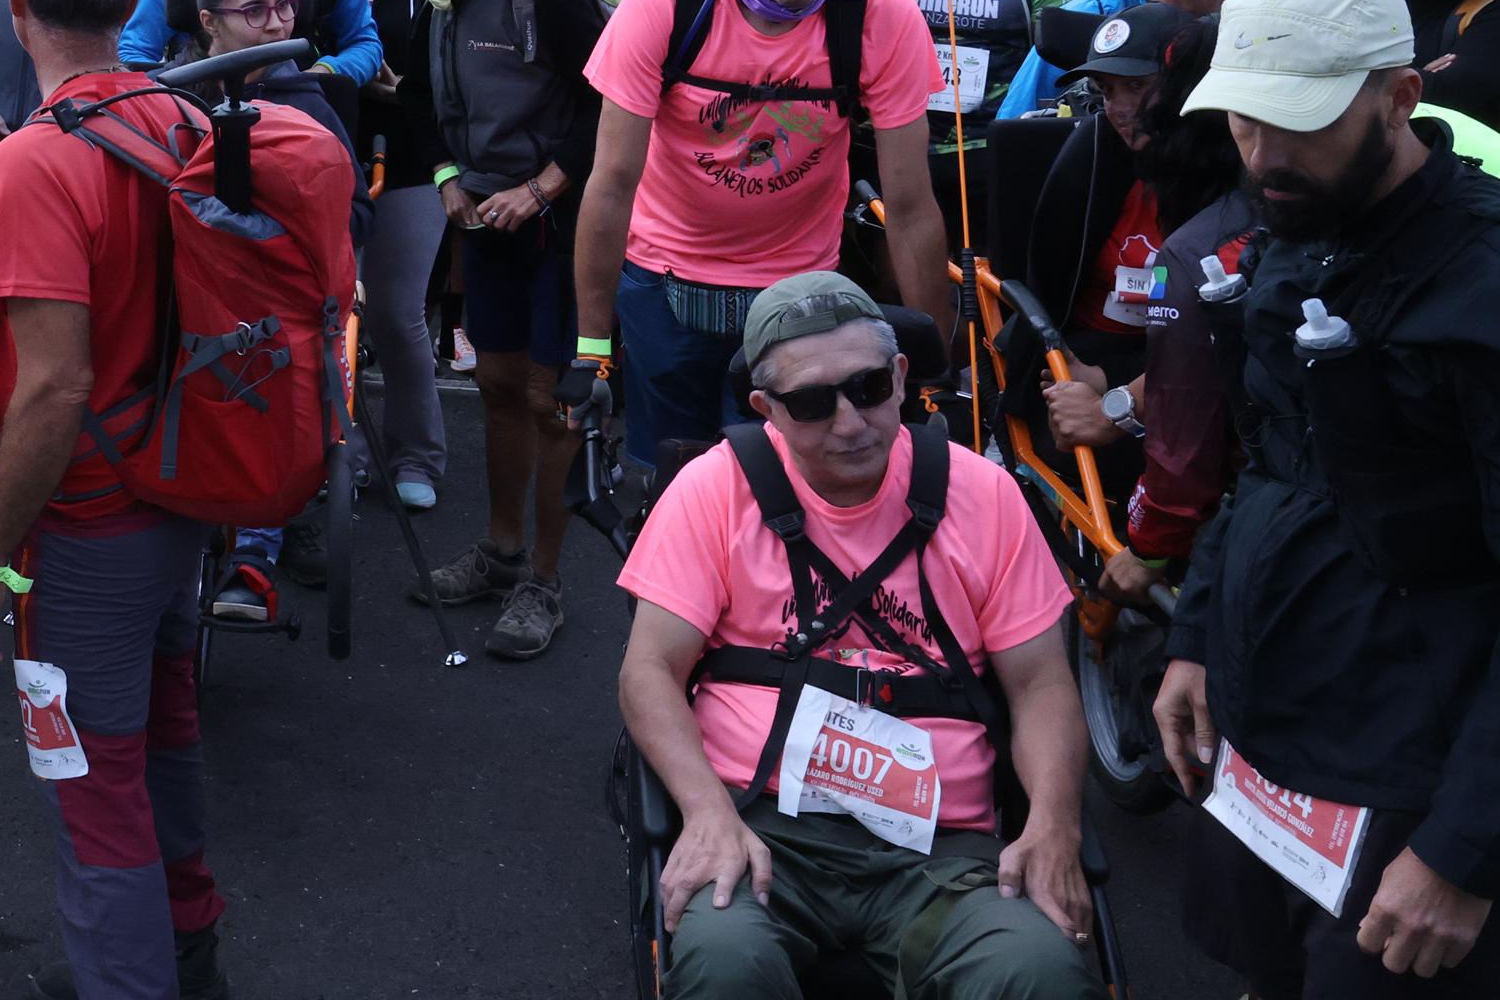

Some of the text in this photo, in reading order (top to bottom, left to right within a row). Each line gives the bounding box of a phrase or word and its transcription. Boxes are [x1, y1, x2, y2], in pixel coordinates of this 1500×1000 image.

[1127, 279, 1145, 291] SIN
[826, 711, 856, 732] ITES
[810, 732, 894, 785] 4007
